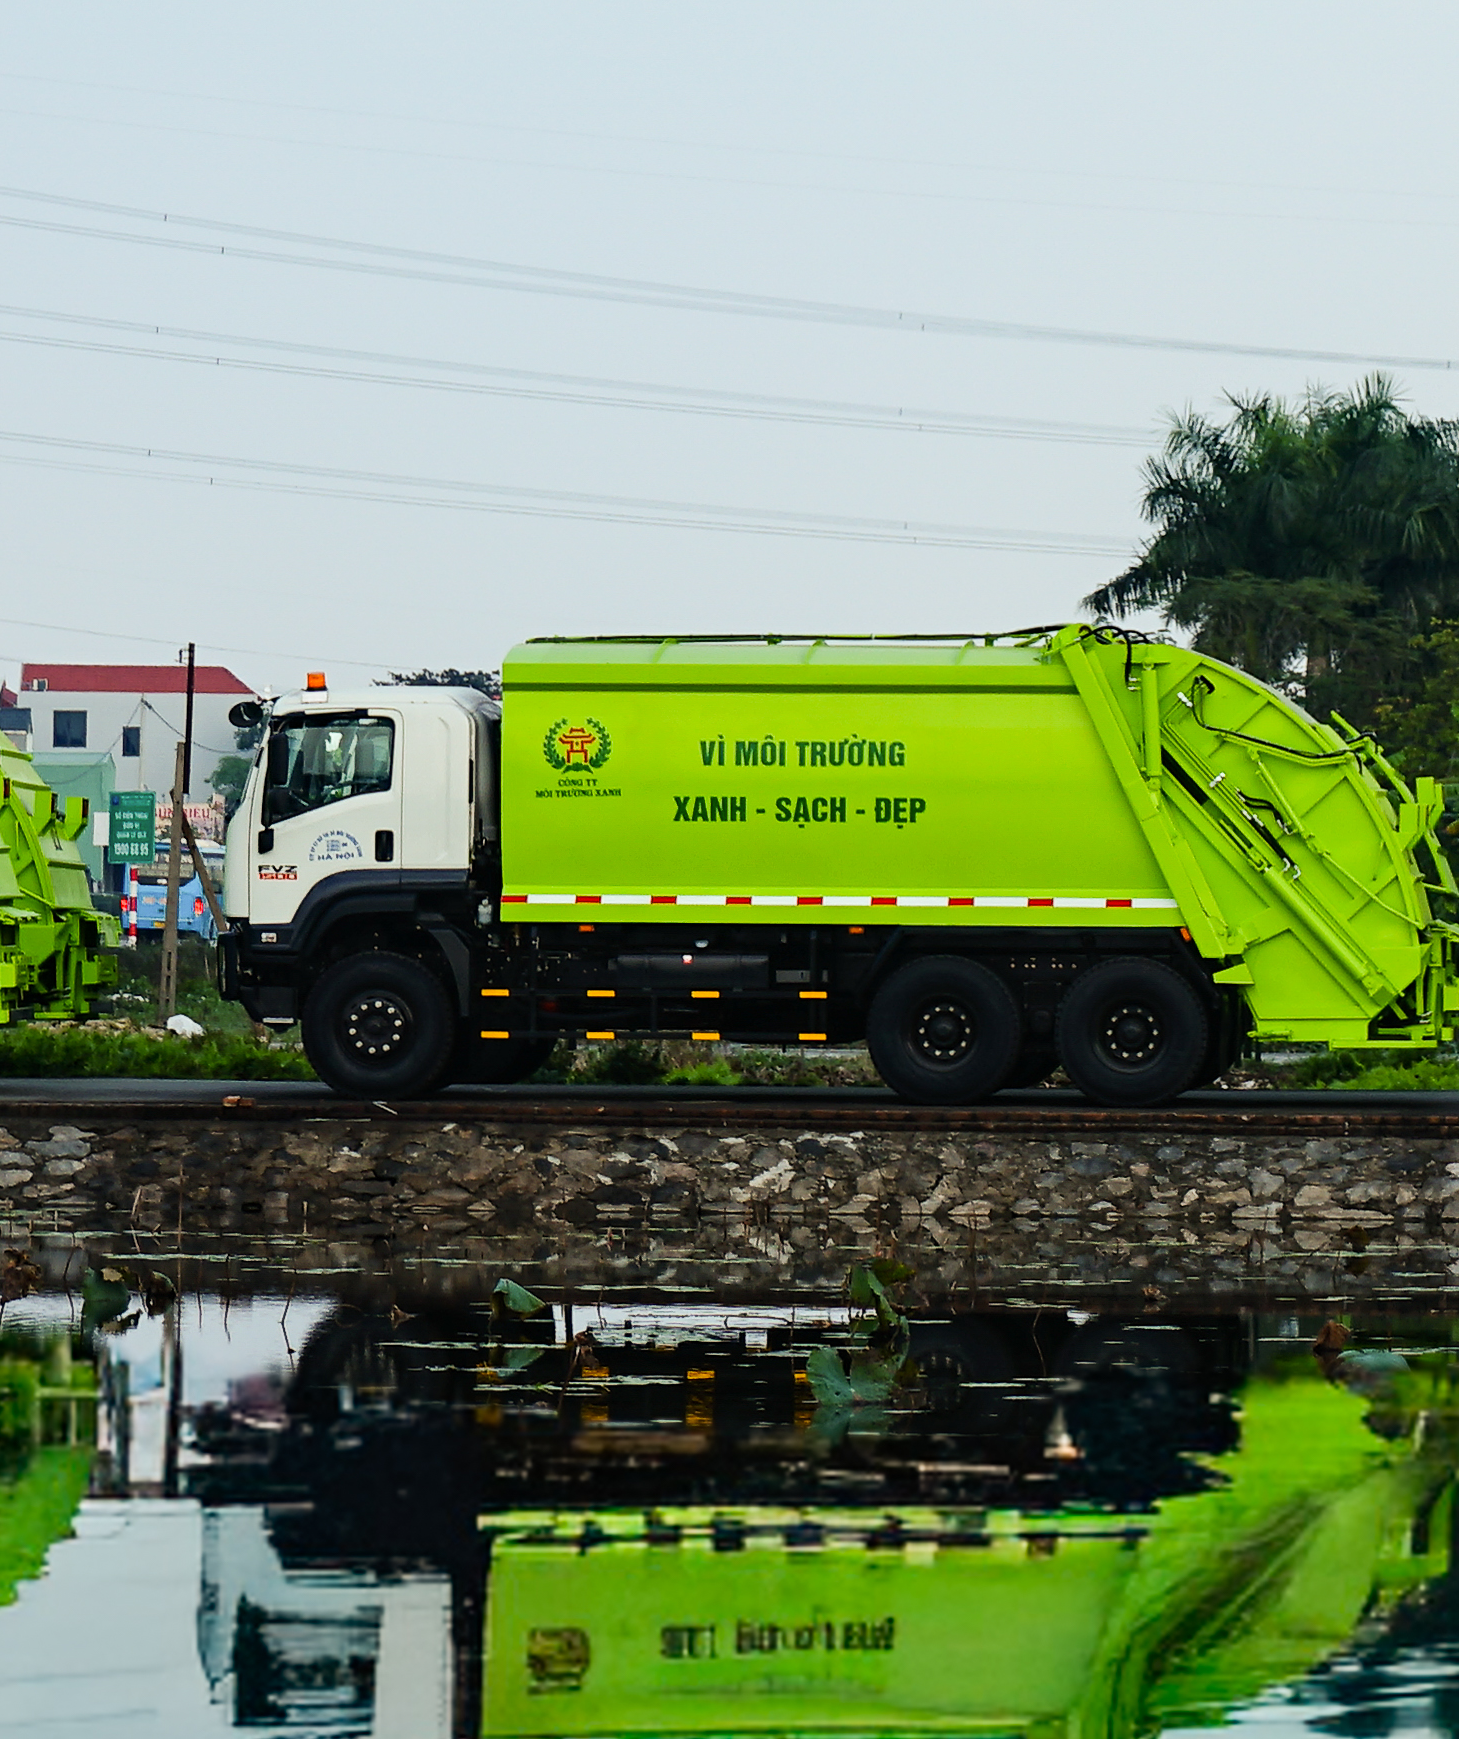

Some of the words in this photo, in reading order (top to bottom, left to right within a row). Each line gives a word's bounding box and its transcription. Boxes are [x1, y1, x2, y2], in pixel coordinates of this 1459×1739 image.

[700, 735, 725, 767] VÌ
[735, 735, 785, 767] MÔI
[795, 734, 905, 767] TRƯỜNG
[586, 779, 597, 787] TY
[595, 789, 622, 797] XANH
[673, 796, 746, 822] XANH
[775, 797, 846, 828] SẠCH
[874, 797, 926, 829] ĐẸP
